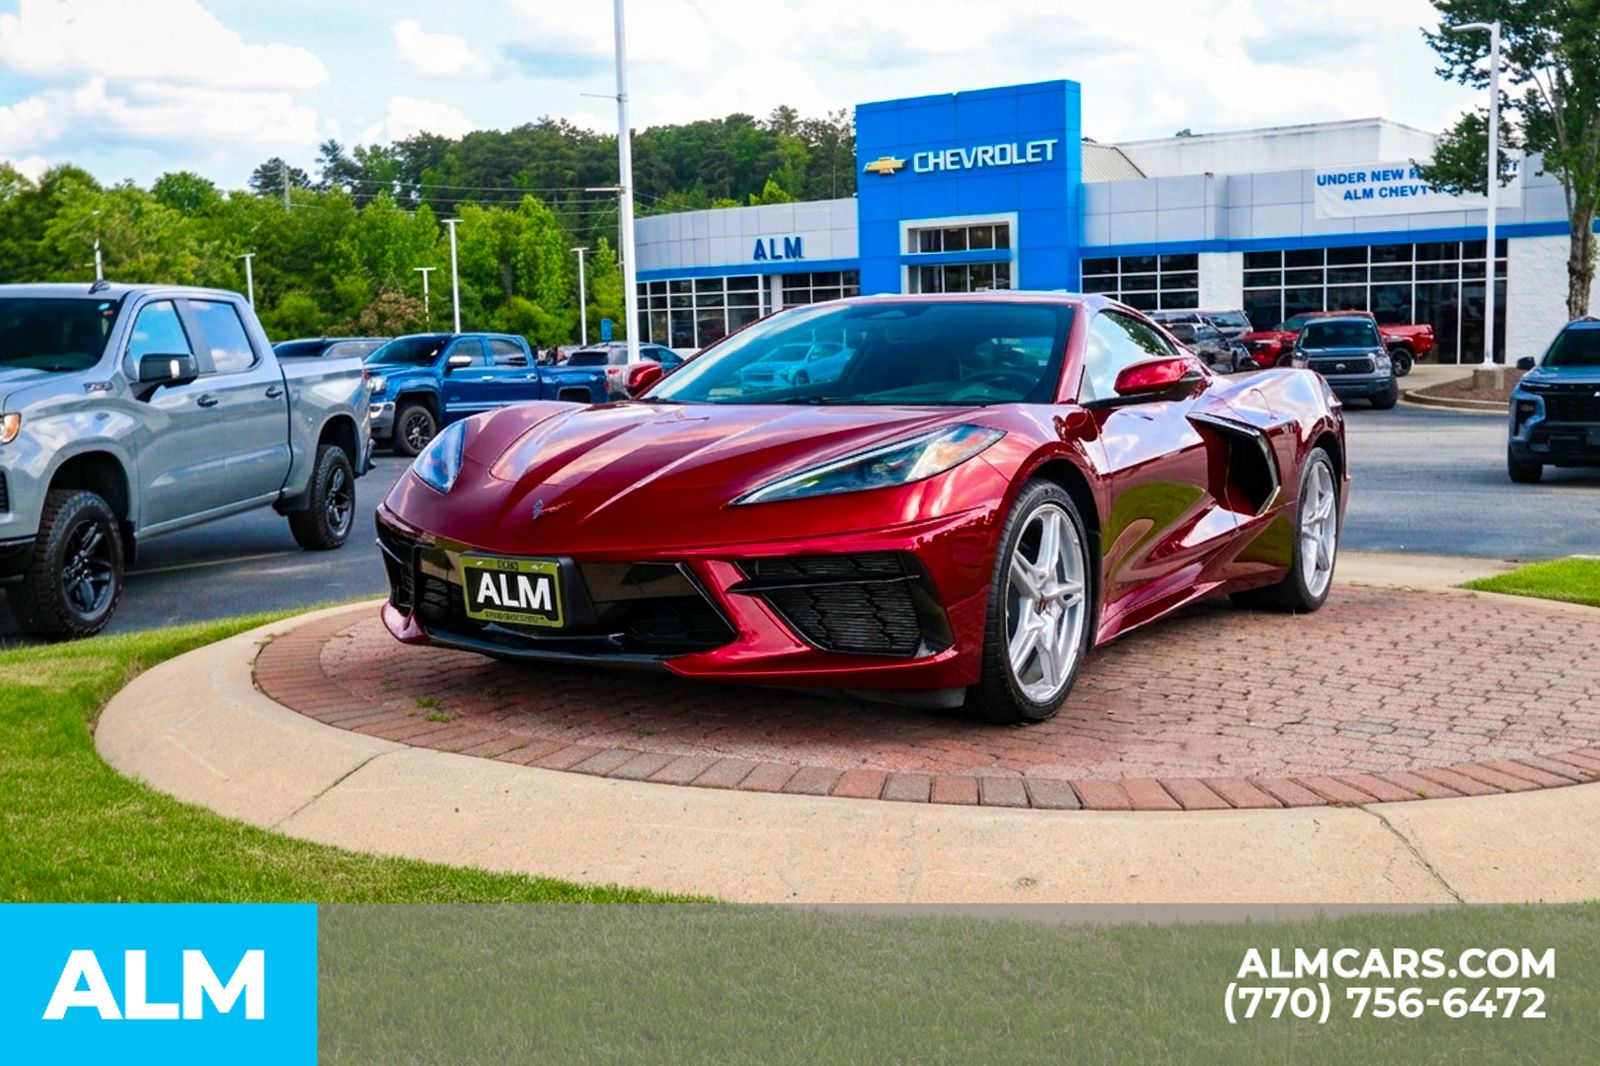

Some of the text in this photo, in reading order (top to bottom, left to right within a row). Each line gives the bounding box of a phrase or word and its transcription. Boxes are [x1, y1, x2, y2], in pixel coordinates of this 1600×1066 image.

[913, 139, 1058, 173] CHEVROLET
[1316, 171, 1367, 186] UNDER
[1371, 168, 1404, 182] NEW
[1343, 187, 1374, 200] ALM
[753, 236, 803, 260] ALM
[477, 572, 552, 610] ALM
